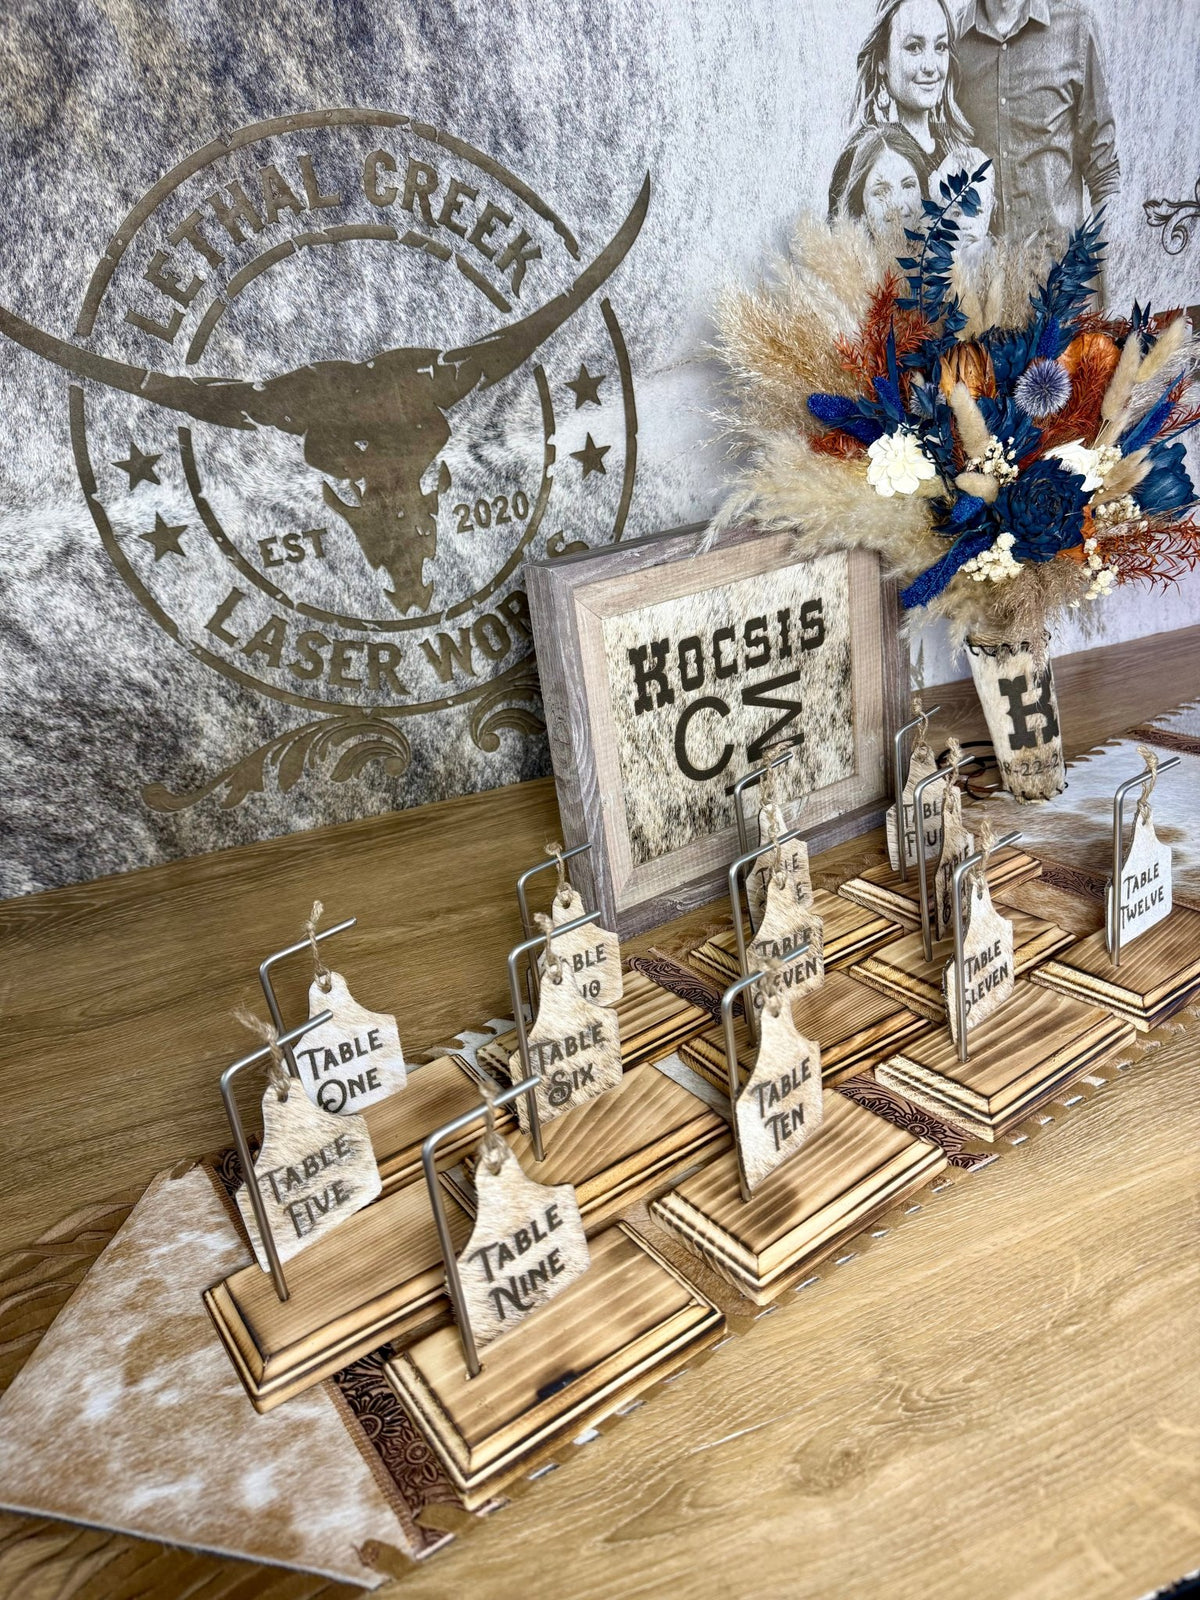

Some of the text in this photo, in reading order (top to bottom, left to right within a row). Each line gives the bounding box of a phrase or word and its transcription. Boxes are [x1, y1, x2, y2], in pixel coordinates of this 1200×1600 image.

[124, 148, 543, 344] LETHAL CREEK
[452, 490, 530, 534] 2020
[257, 527, 330, 568] EST
[203, 585, 411, 695] LASER
[626, 596, 826, 716] KOCSIS
[902, 800, 941, 829] TBL
[903, 827, 943, 858] FU
[1123, 862, 1160, 900] TABLE
[1119, 885, 1165, 930] TWELVE
[559, 942, 607, 975] BLE
[963, 939, 1002, 983] TABLE
[297, 1028, 384, 1081] TABLE
[529, 1022, 609, 1076] TABLE
[316, 1066, 383, 1115] ONE
[548, 1062, 597, 1107] SIX
[752, 1055, 812, 1120] TABLE
[764, 1102, 805, 1154] TEN
[256, 1131, 352, 1205] TABLE
[284, 1178, 355, 1240] FIVE
[467, 1203, 564, 1282] TABLE
[488, 1248, 567, 1322] NINE
